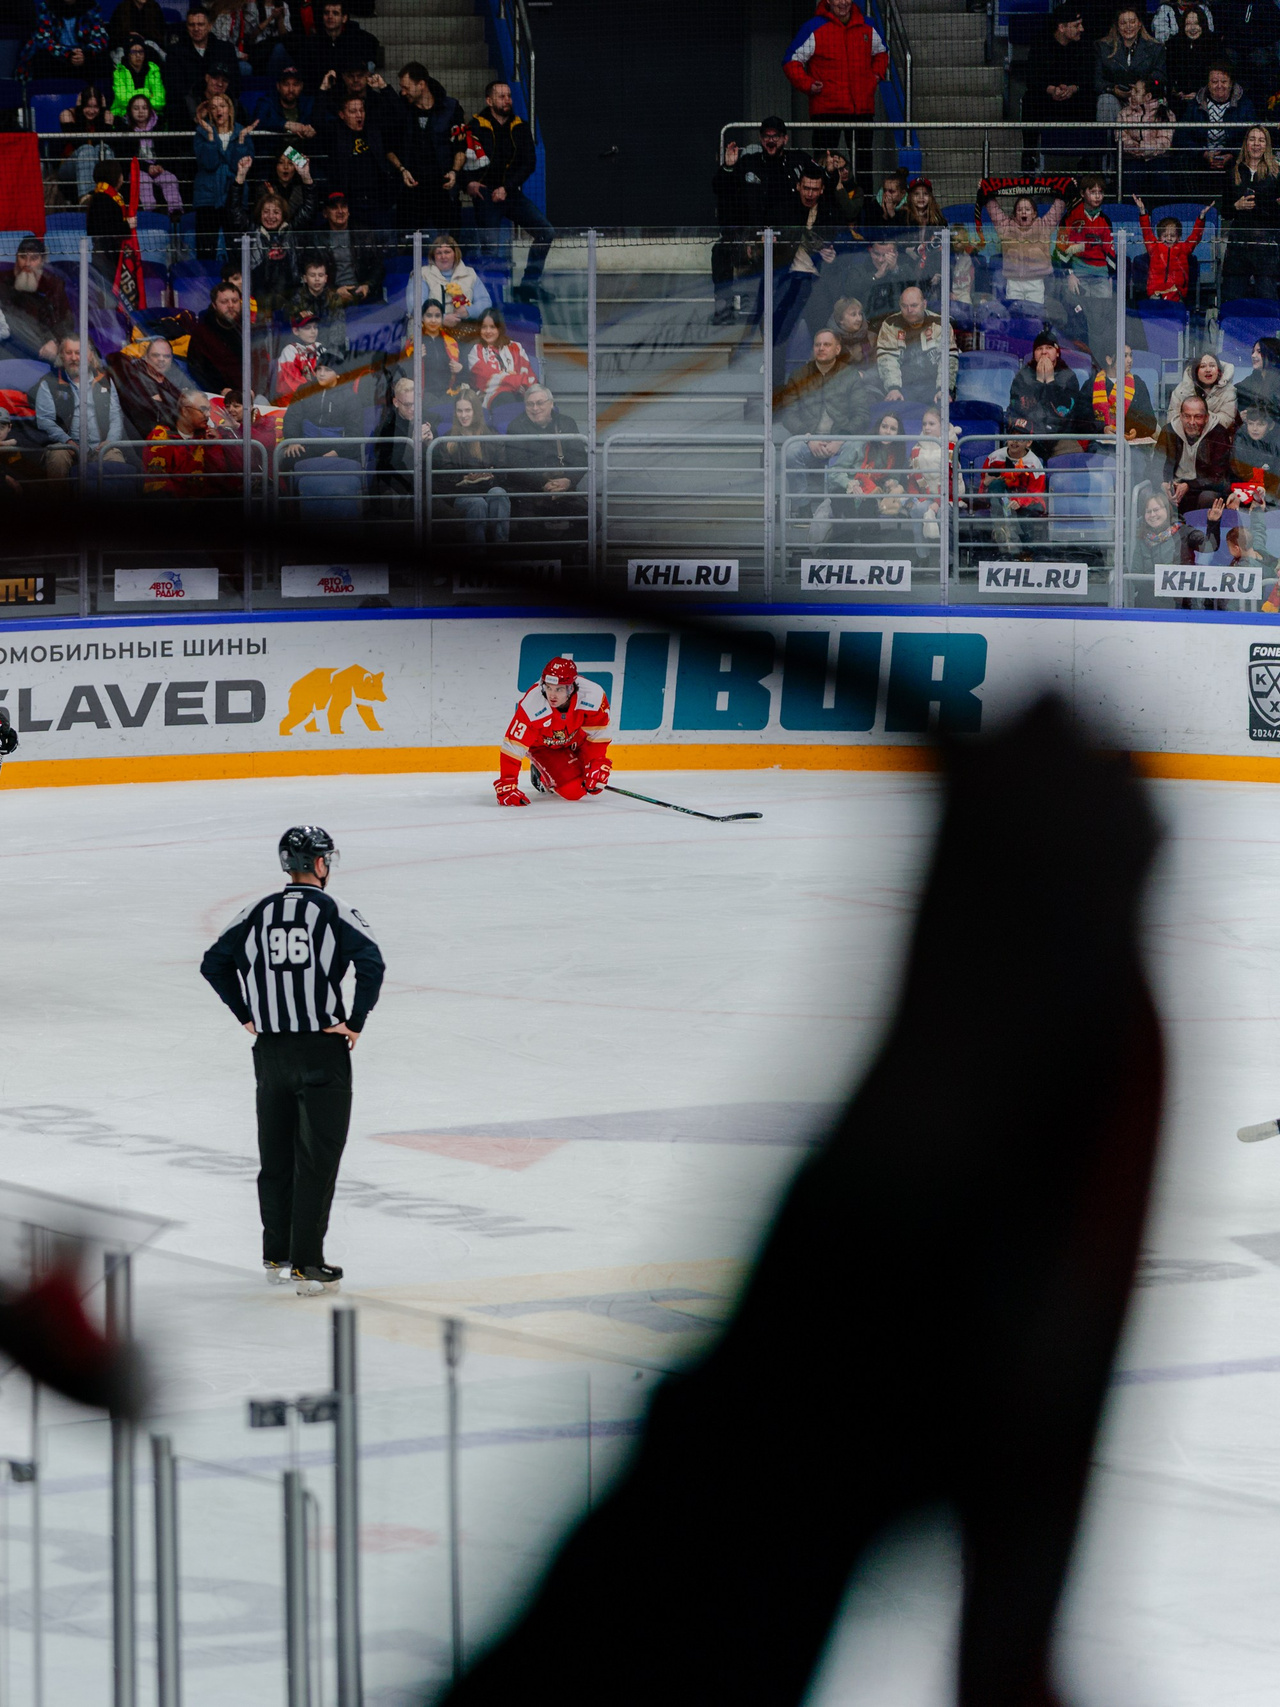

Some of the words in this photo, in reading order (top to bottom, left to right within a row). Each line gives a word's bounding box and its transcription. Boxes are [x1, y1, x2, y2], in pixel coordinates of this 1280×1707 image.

[316, 577, 341, 586] АВТО
[634, 564, 733, 586] KHL.RU
[807, 564, 905, 586] KHL.RU
[985, 567, 1081, 589] KHL.RU
[1161, 570, 1255, 593] KHL.RU
[148, 582, 173, 590] АВТО
[155, 589, 185, 598] РАДИО
[323, 584, 354, 593] РАДИО
[183, 637, 267, 657] ШИНЫ
[517, 631, 988, 733] SIBUR
[510, 719, 527, 740] 13
[269, 927, 309, 965] 96
